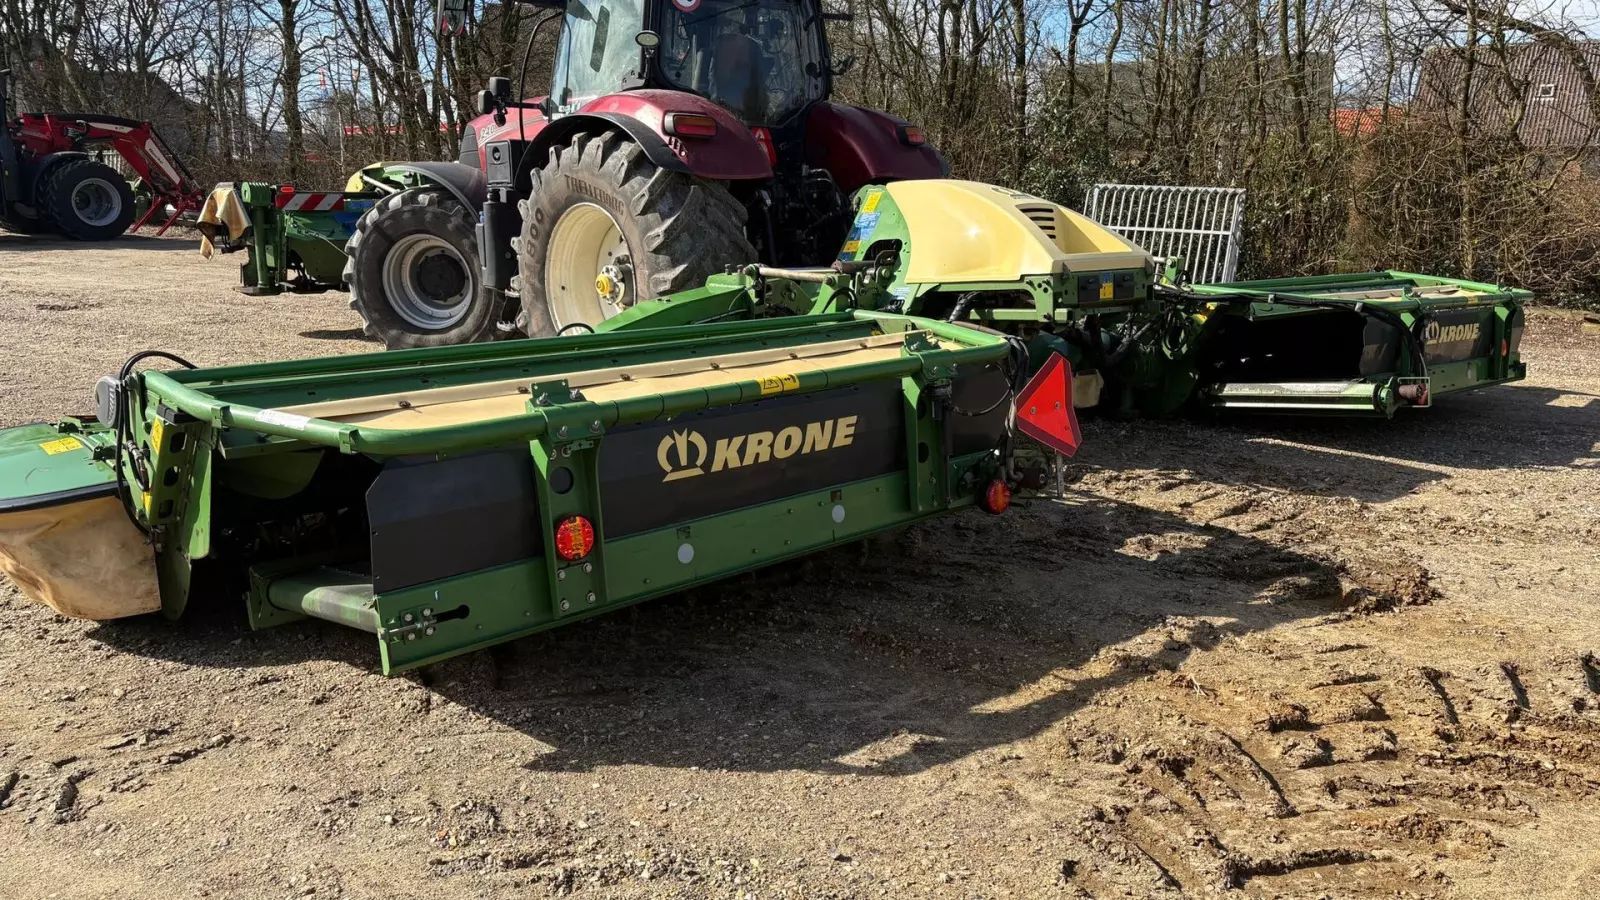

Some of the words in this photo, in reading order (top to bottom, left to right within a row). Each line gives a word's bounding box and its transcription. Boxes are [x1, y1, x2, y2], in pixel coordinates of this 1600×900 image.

[526, 207, 544, 258] 800
[1439, 322, 1480, 343] KRONE
[711, 415, 858, 473] KRONE
